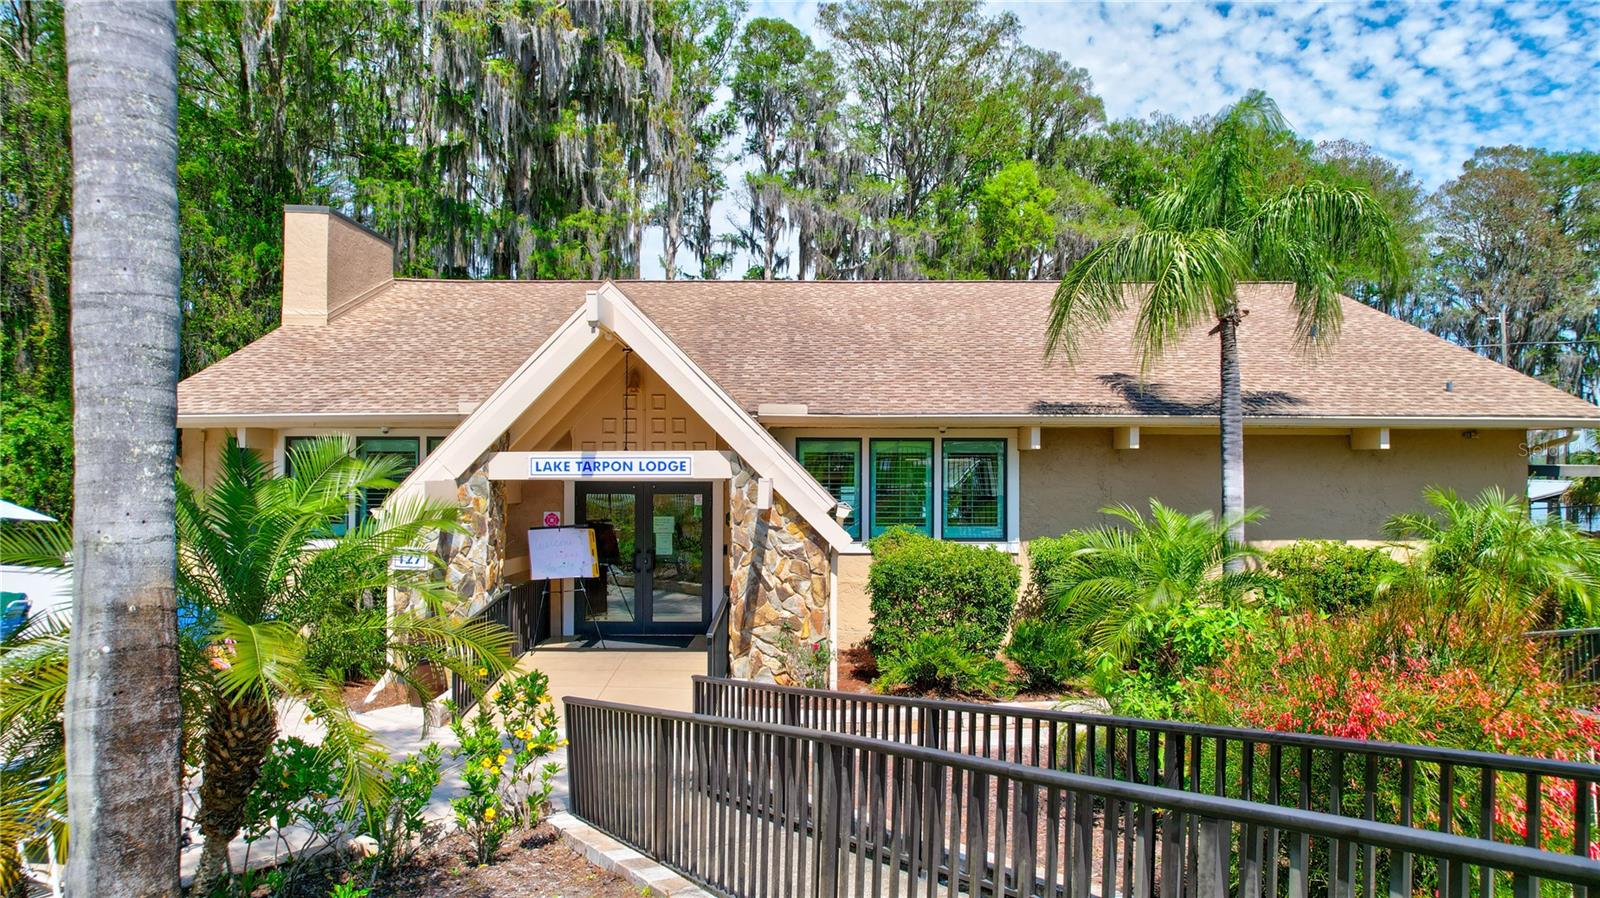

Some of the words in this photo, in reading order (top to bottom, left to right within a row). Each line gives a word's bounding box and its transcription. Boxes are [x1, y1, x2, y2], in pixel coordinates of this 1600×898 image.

[535, 461, 570, 472] LAKE
[576, 461, 633, 472] TARPON
[638, 461, 687, 472] LODGE
